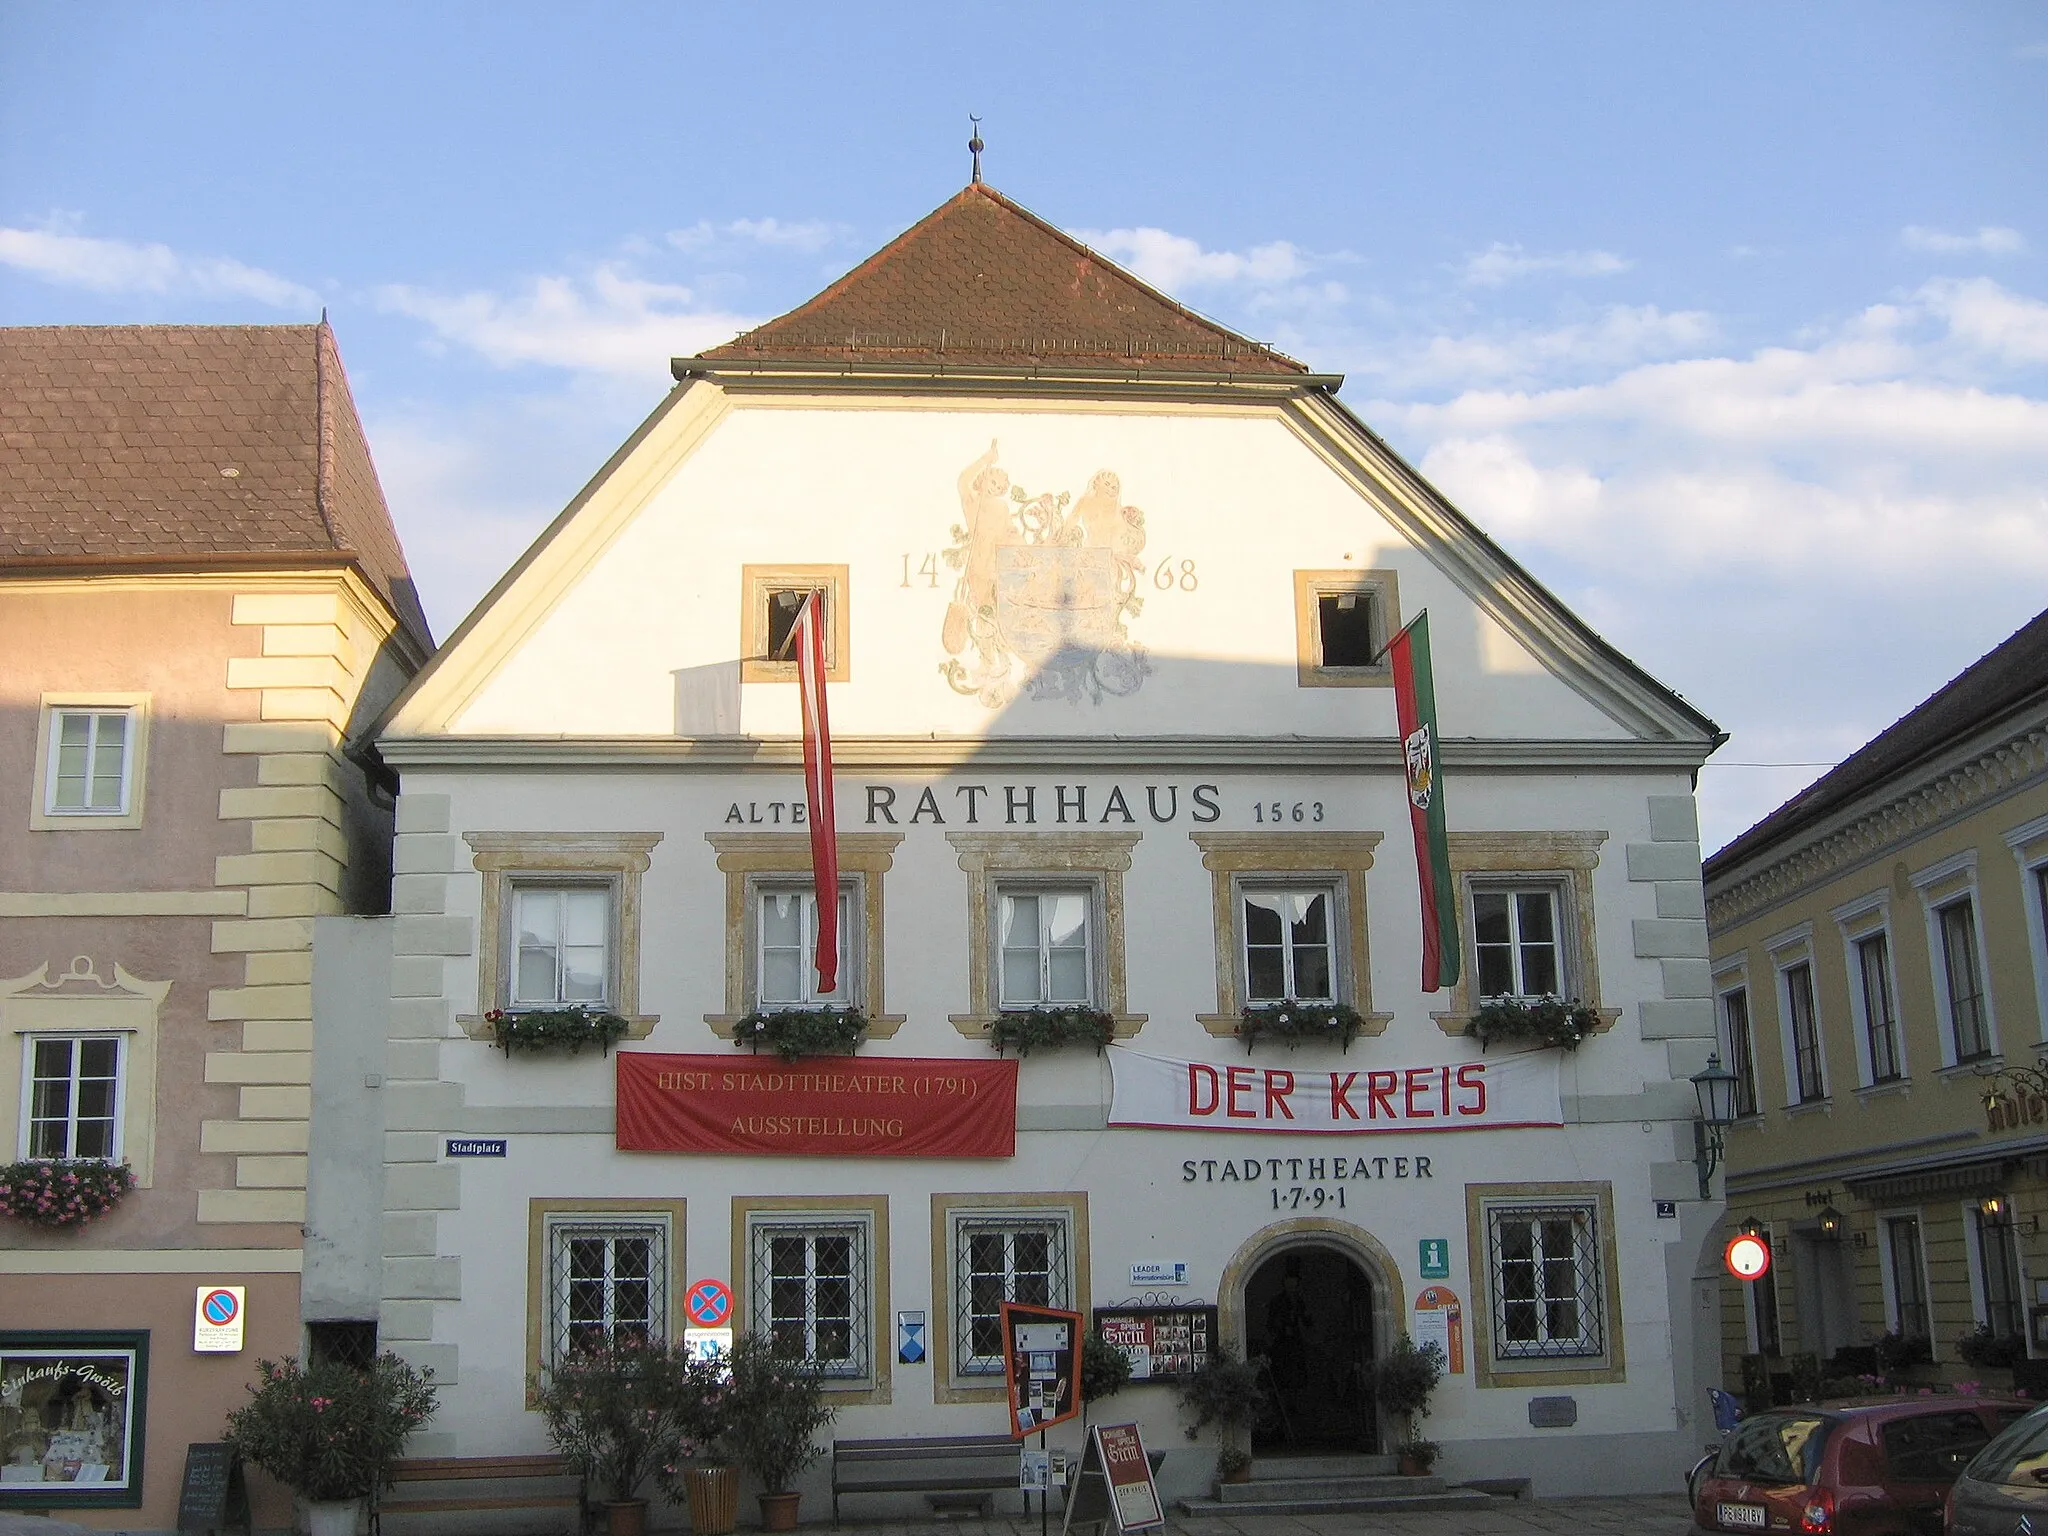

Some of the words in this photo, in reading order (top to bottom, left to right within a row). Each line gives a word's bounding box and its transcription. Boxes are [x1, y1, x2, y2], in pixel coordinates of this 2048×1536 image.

[900, 552, 939, 589] 14
[1153, 555, 1199, 592] 68
[725, 802, 807, 824] ALTE
[864, 784, 1221, 824] RATHHAUS
[1253, 802, 1325, 823] 1563
[658, 1072, 714, 1091] HIST.
[722, 1073, 907, 1095] STADTTHEATER
[913, 1076, 978, 1101] (1791)
[1188, 1063, 1295, 1120] DER
[1329, 1064, 1488, 1120] KREIS
[730, 1116, 904, 1137] AUSSTELLUNG
[451, 1142, 501, 1155] Stadtplatz
[1182, 1156, 1434, 1183] STADTTHEATER
[1663, 1203, 1669, 1212] 7
[1132, 1265, 1161, 1273] LEADER
[1102, 1327, 1146, 1345] Grein
